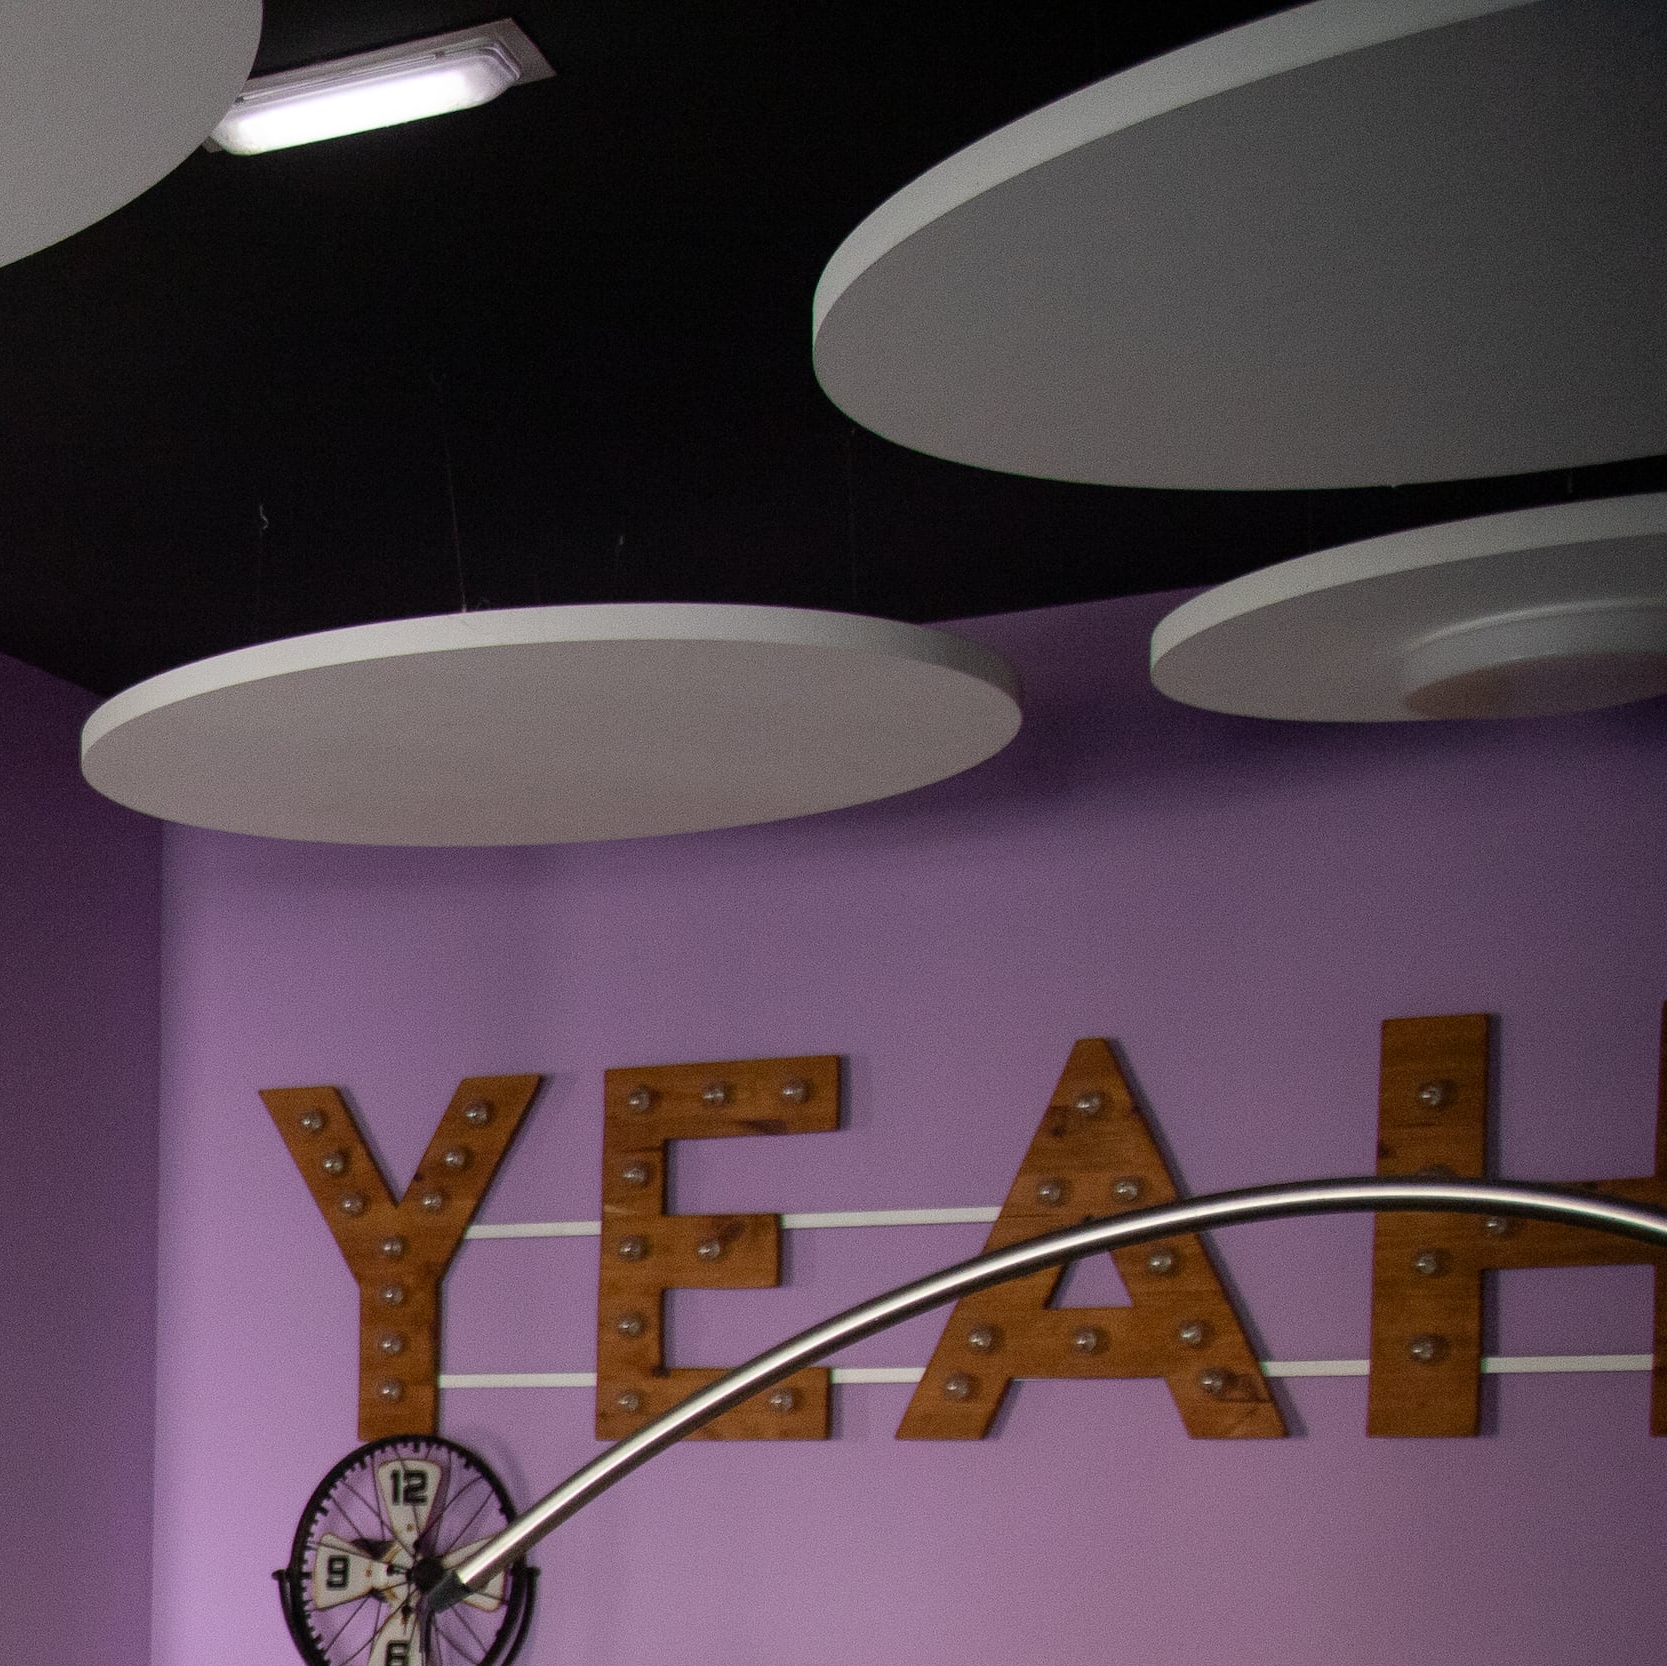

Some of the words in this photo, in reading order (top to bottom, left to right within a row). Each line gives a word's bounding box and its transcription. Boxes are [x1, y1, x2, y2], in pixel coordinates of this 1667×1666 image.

[258, 1000, 1667, 1441] YEAH
[390, 1468, 429, 1505] 12
[326, 1553, 352, 1591] 9
